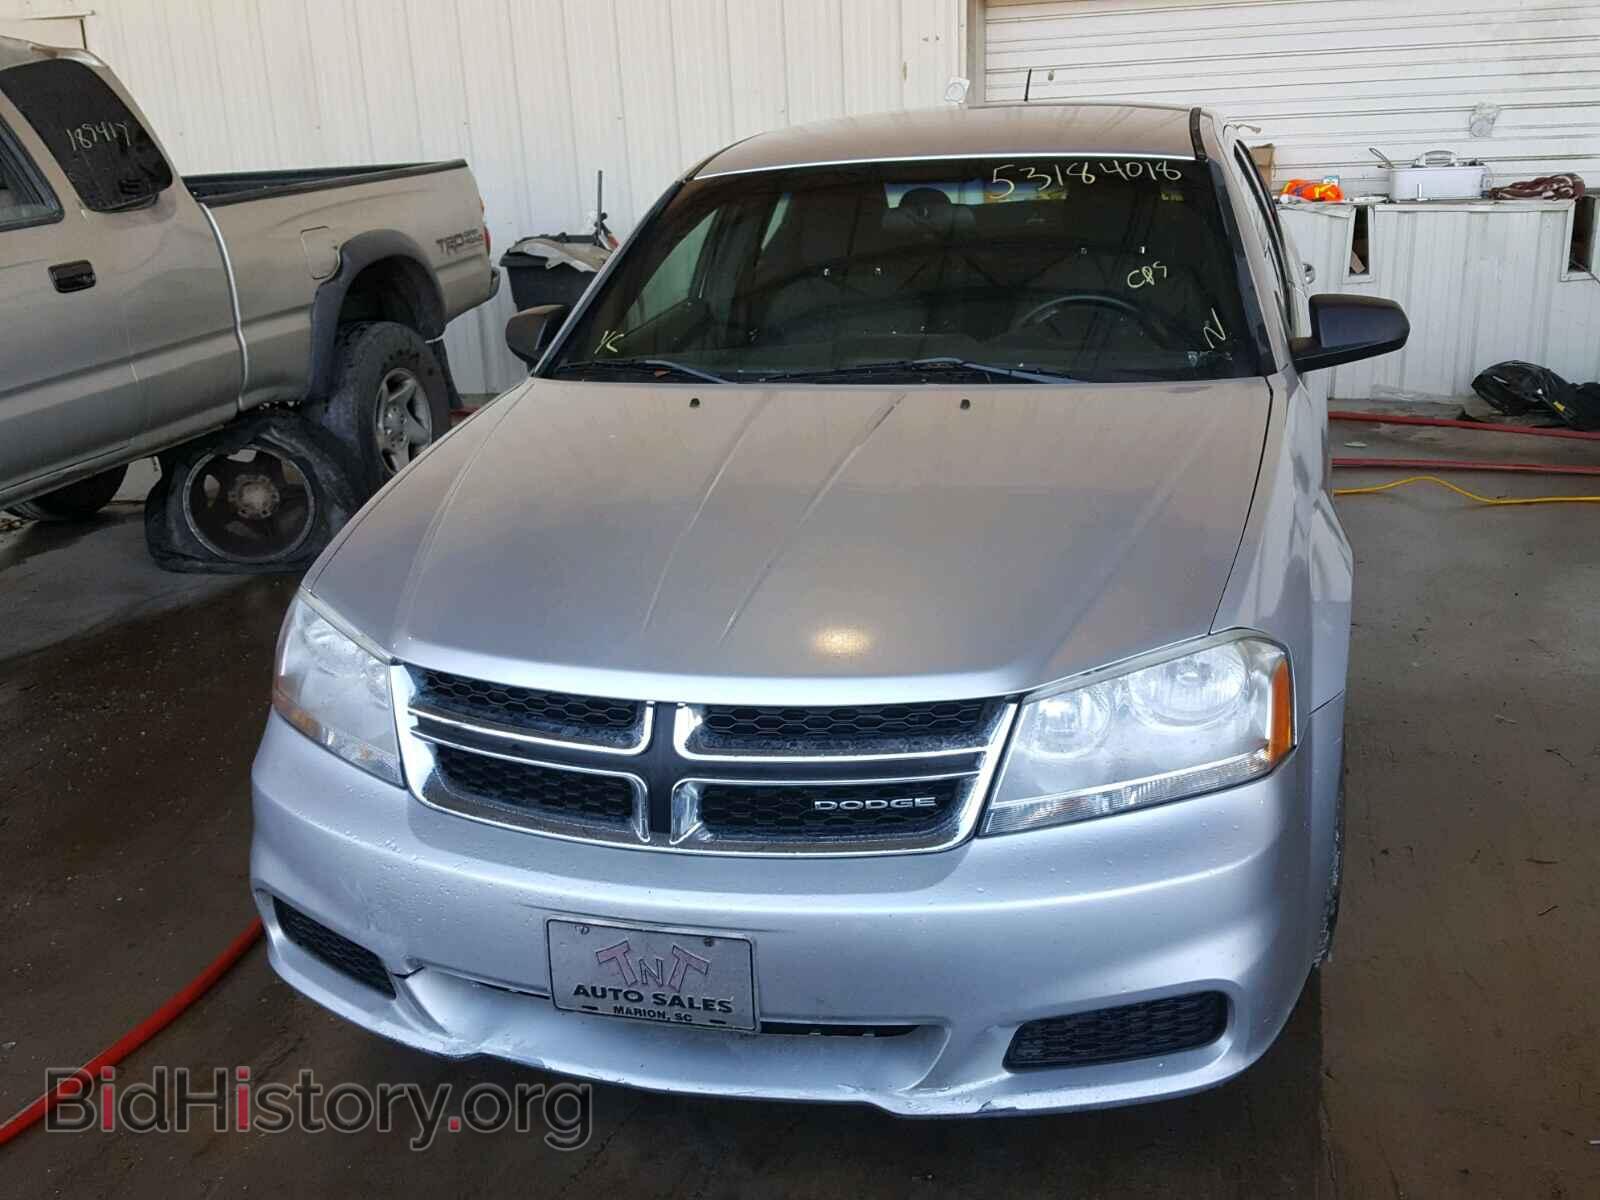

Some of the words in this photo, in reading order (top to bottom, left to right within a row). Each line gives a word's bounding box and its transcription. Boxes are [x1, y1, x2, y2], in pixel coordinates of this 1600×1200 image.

[814, 796, 937, 811] DODGE
[596, 937, 712, 993] TNT
[573, 984, 644, 1004] AUTO
[652, 992, 733, 1014] SALES
[613, 1005, 671, 1022] MARION,
[674, 1012, 693, 1023] SC
